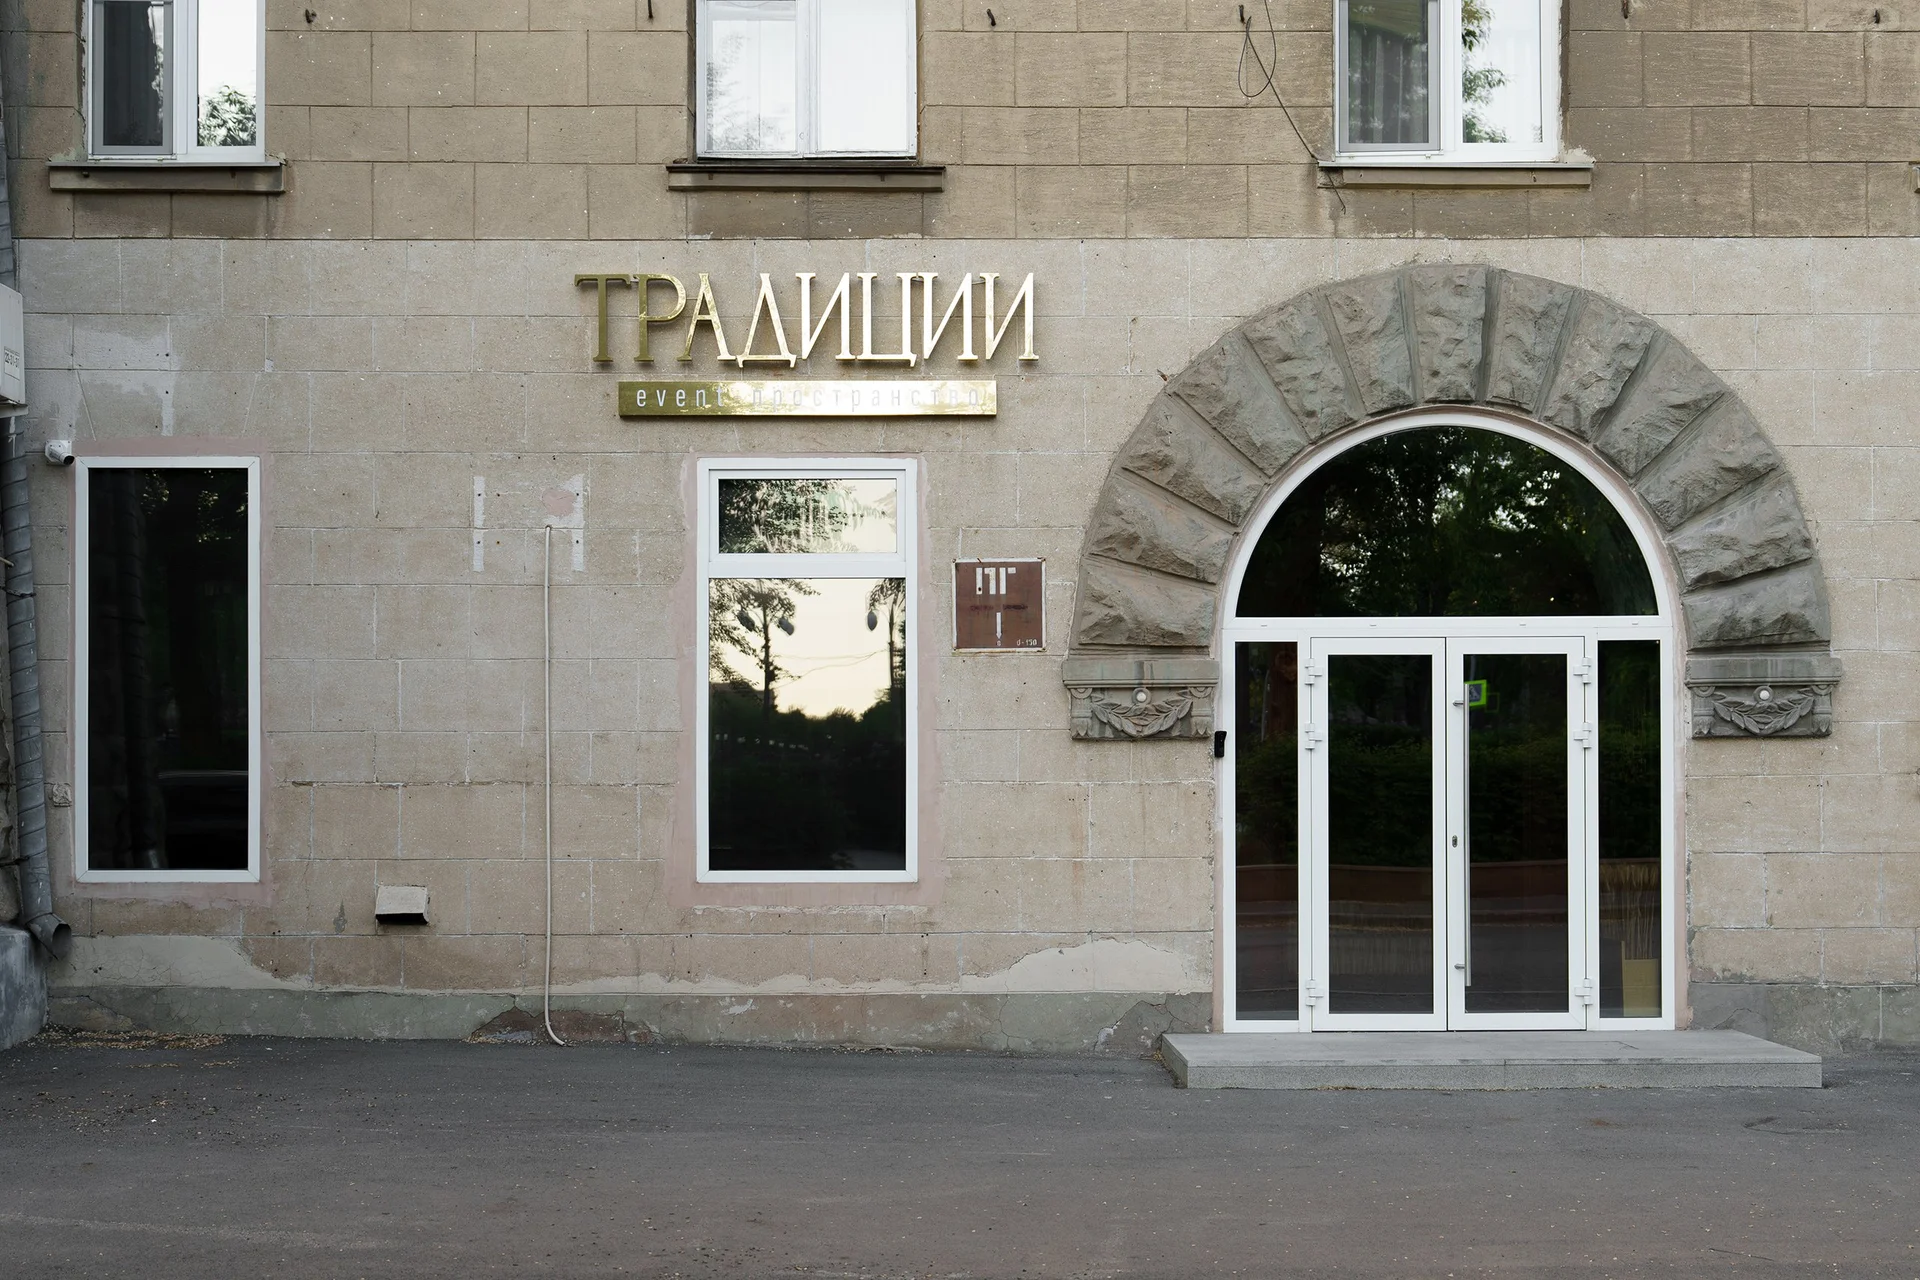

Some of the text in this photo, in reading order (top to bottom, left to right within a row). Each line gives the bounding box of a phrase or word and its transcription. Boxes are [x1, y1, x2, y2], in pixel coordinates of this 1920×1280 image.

[574, 272, 1039, 368] ТРАДИЦИИ
[635, 384, 979, 413] event пространство
